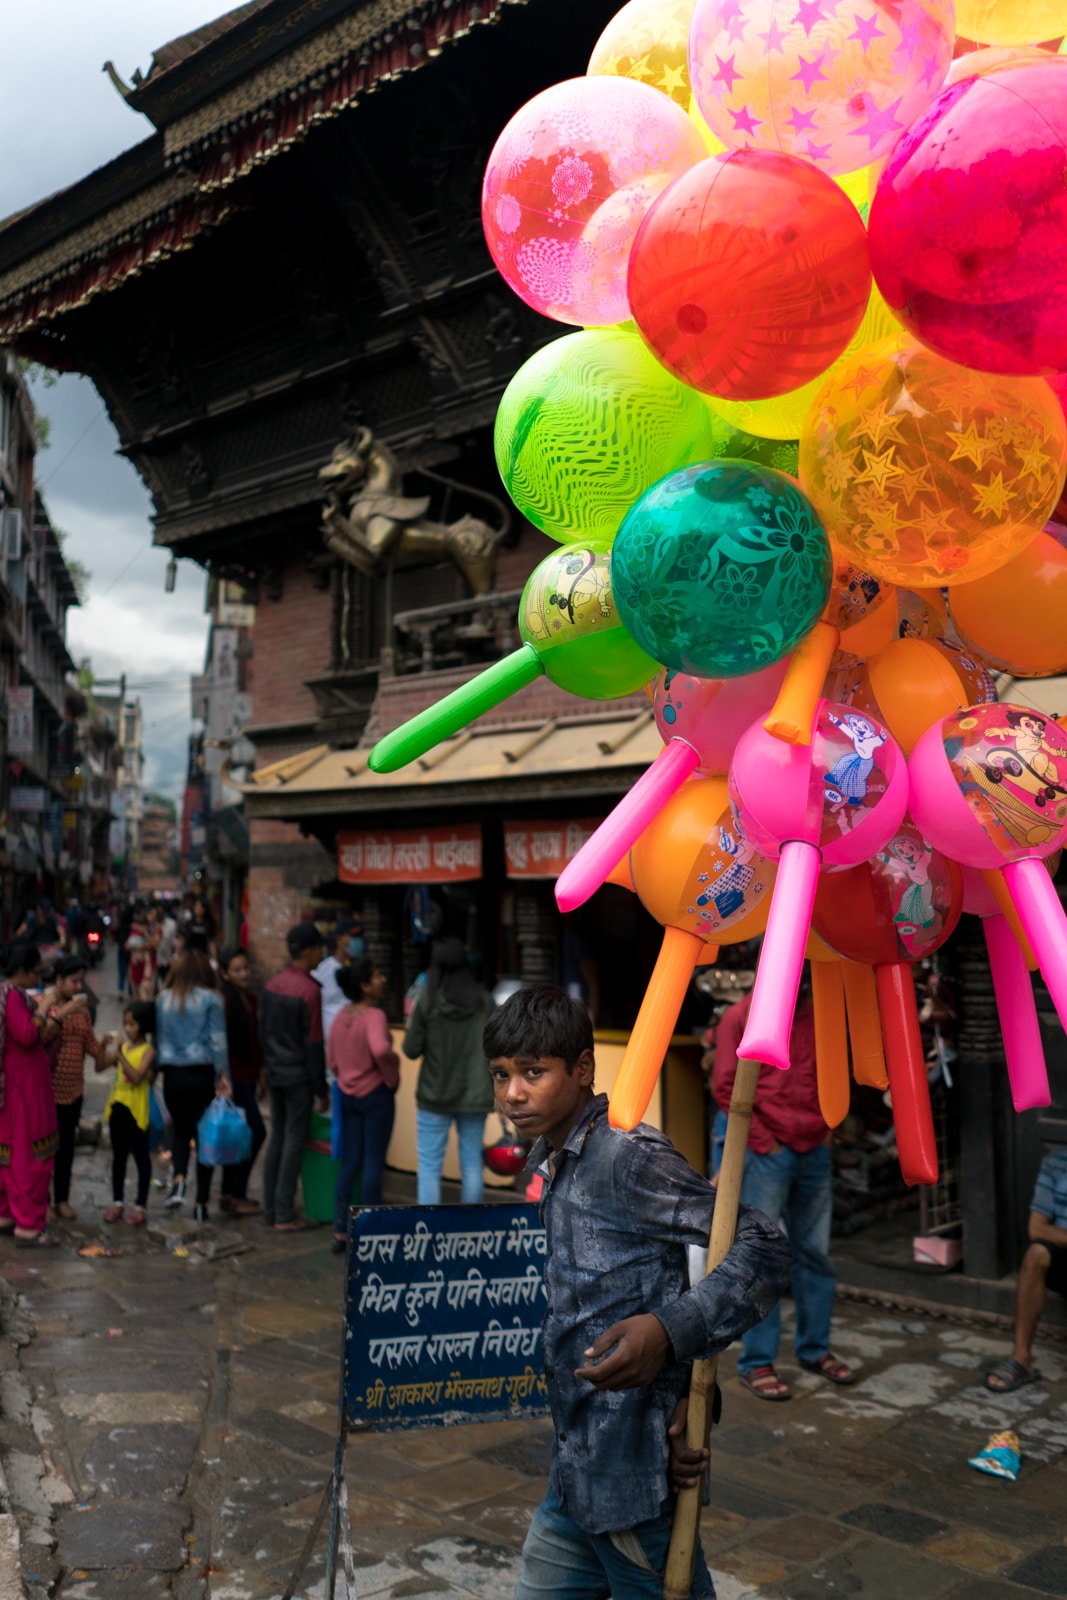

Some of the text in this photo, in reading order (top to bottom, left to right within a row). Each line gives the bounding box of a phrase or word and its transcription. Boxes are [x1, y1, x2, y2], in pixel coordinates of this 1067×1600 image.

[356, 1234, 401, 1264] यस
[403, 1221, 433, 1263] श्री
[432, 1230, 506, 1262] आकाश
[358, 1272, 406, 1314] भित्र
[405, 1269, 444, 1327] कुनै
[446, 1268, 487, 1310] पनि
[485, 1265, 542, 1309] सवारी
[368, 1316, 542, 1370] पसल राख्न निषेध
[366, 1378, 386, 1410] श्री
[386, 1381, 444, 1410] आकाश
[443, 1371, 505, 1402] भैरवनाथ
[505, 1365, 537, 1408] गुठी
